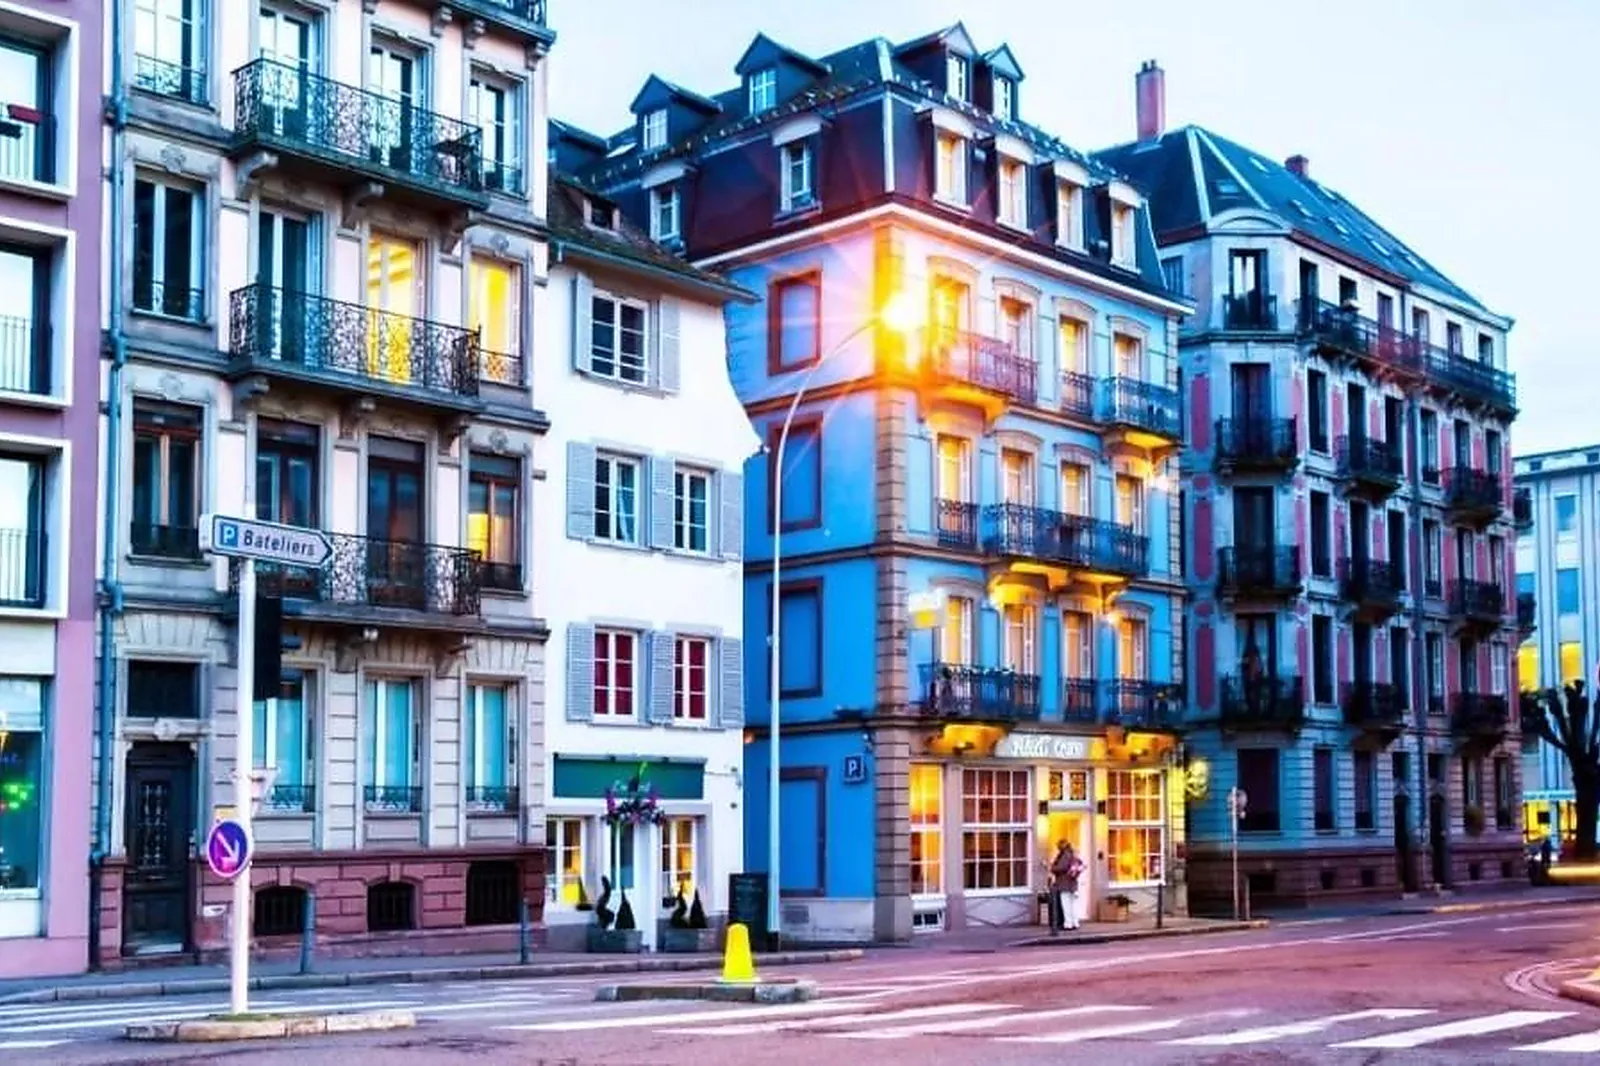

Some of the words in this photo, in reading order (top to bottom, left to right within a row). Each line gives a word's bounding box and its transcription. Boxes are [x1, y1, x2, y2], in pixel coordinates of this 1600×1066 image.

[222, 525, 235, 544] P
[243, 529, 315, 556] Bateliers
[848, 759, 857, 777] P
